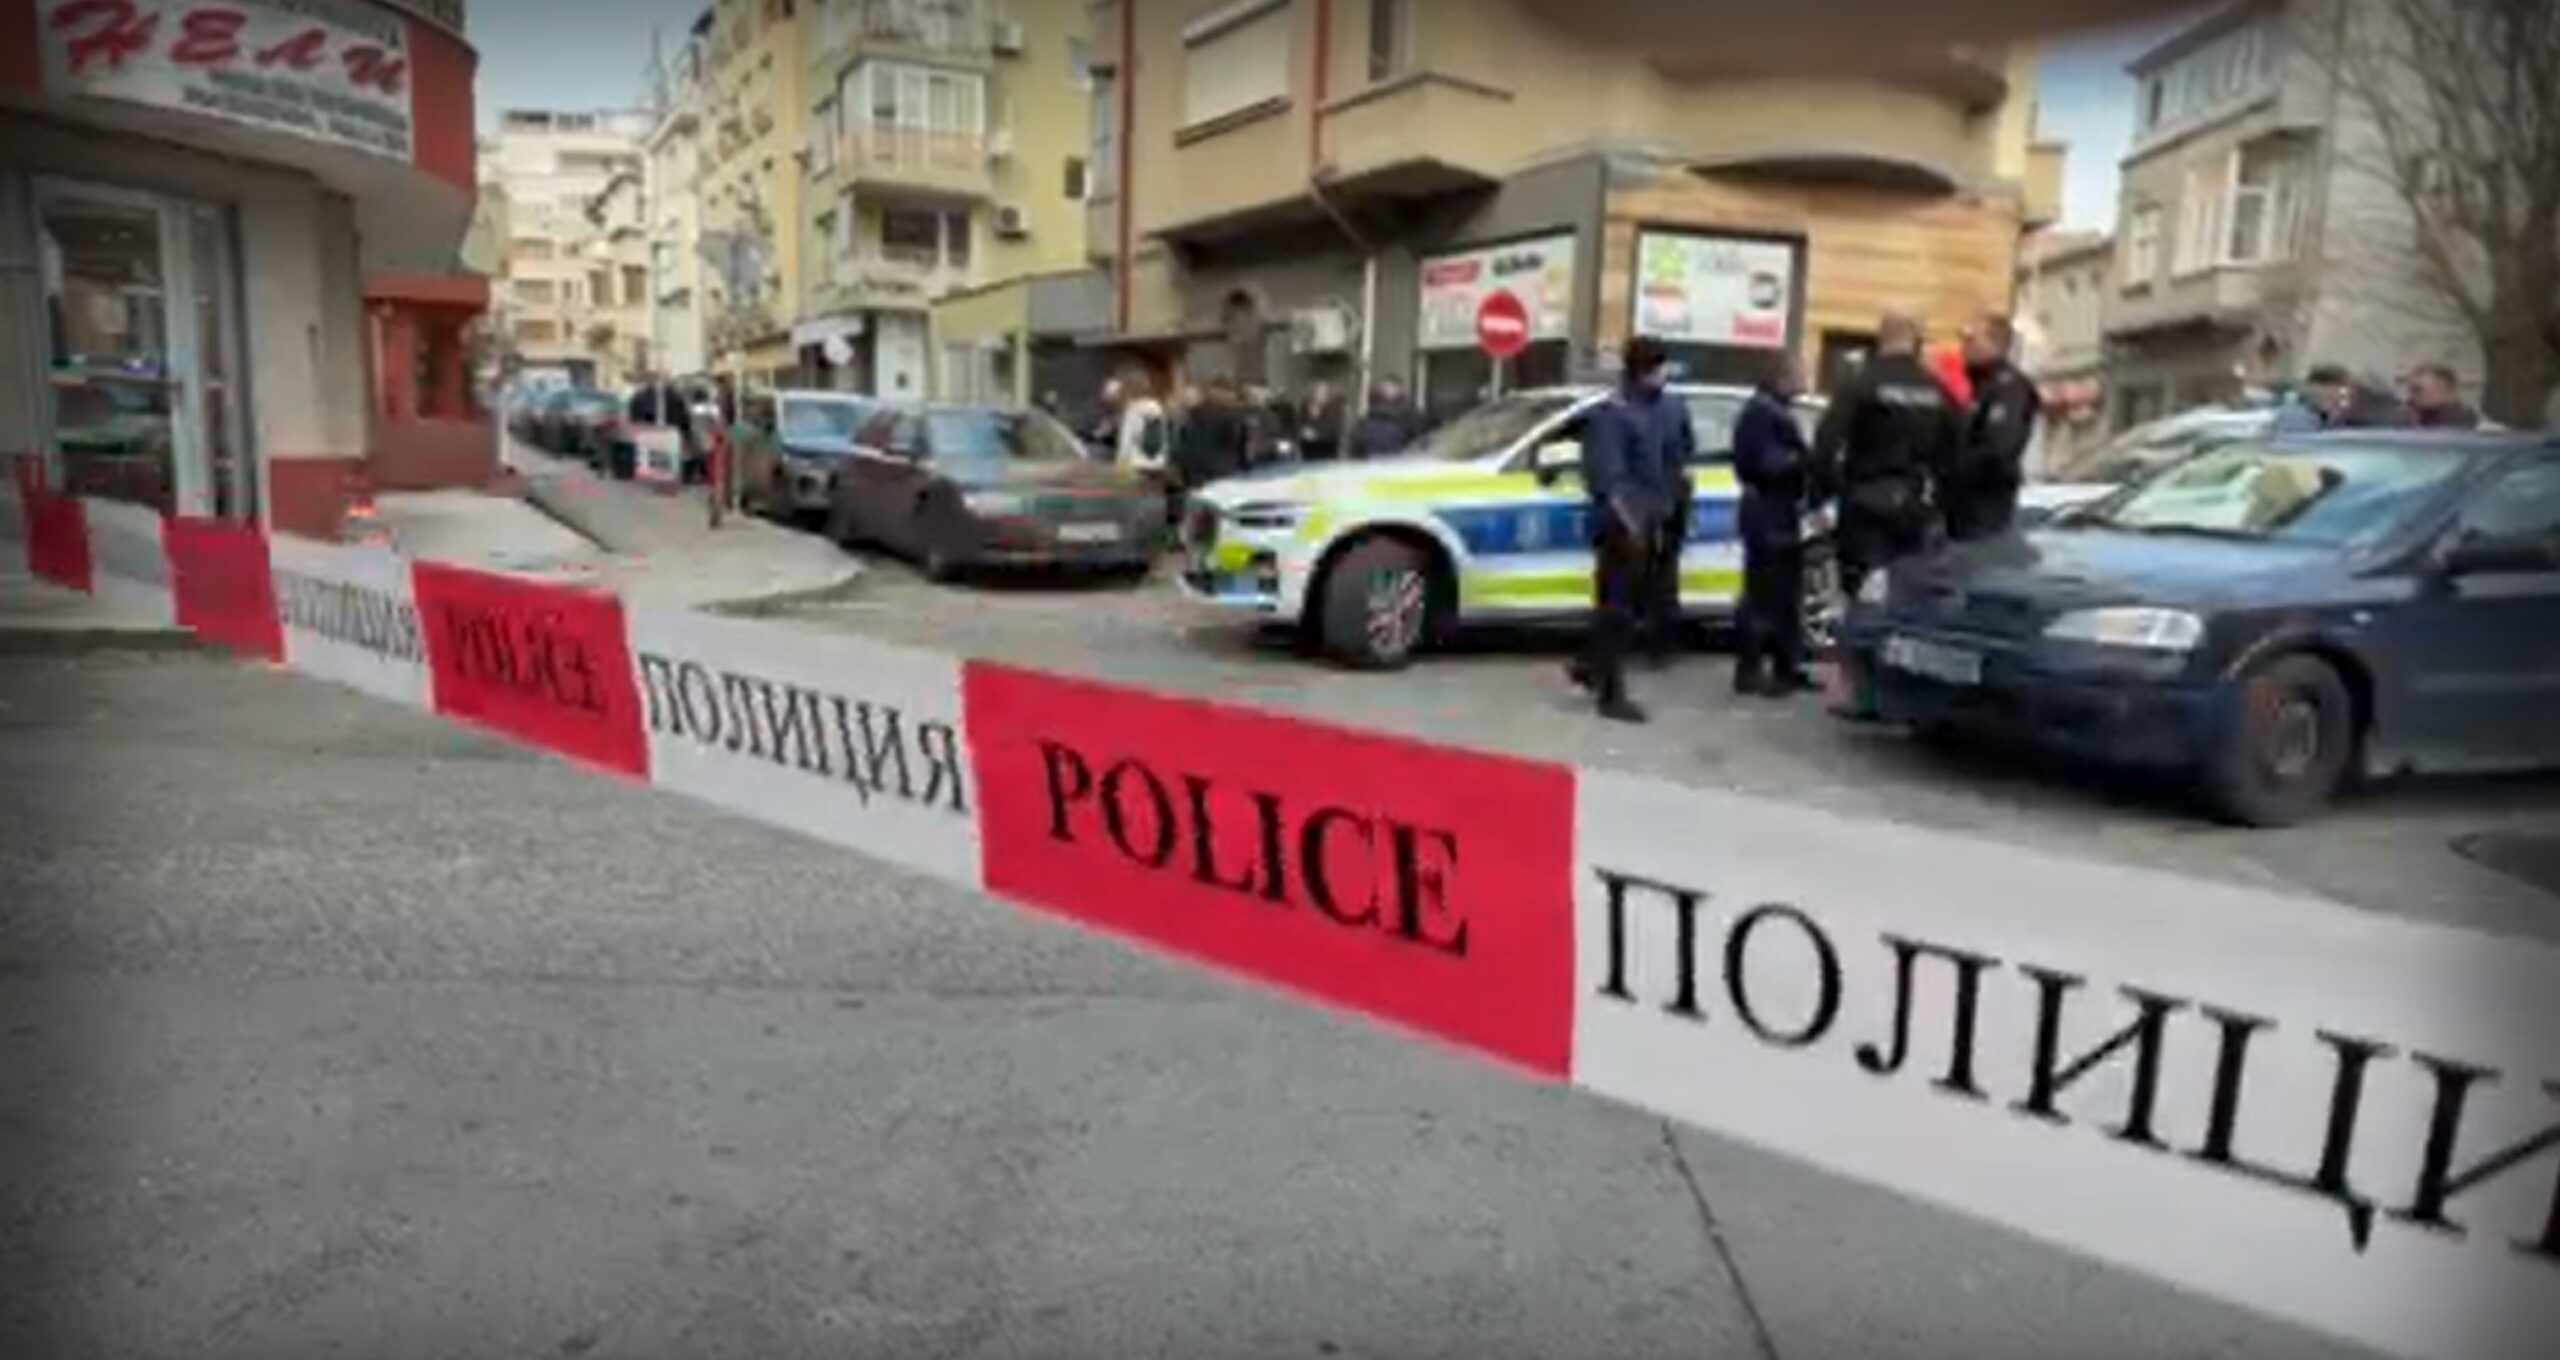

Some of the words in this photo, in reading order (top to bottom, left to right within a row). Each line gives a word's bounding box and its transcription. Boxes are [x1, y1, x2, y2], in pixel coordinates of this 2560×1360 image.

[639, 653, 966, 812] ПОЛИЦИЯ
[1040, 738, 1469, 957] POLICE
[1593, 867, 2560, 1254] ПОЛИЦИ
